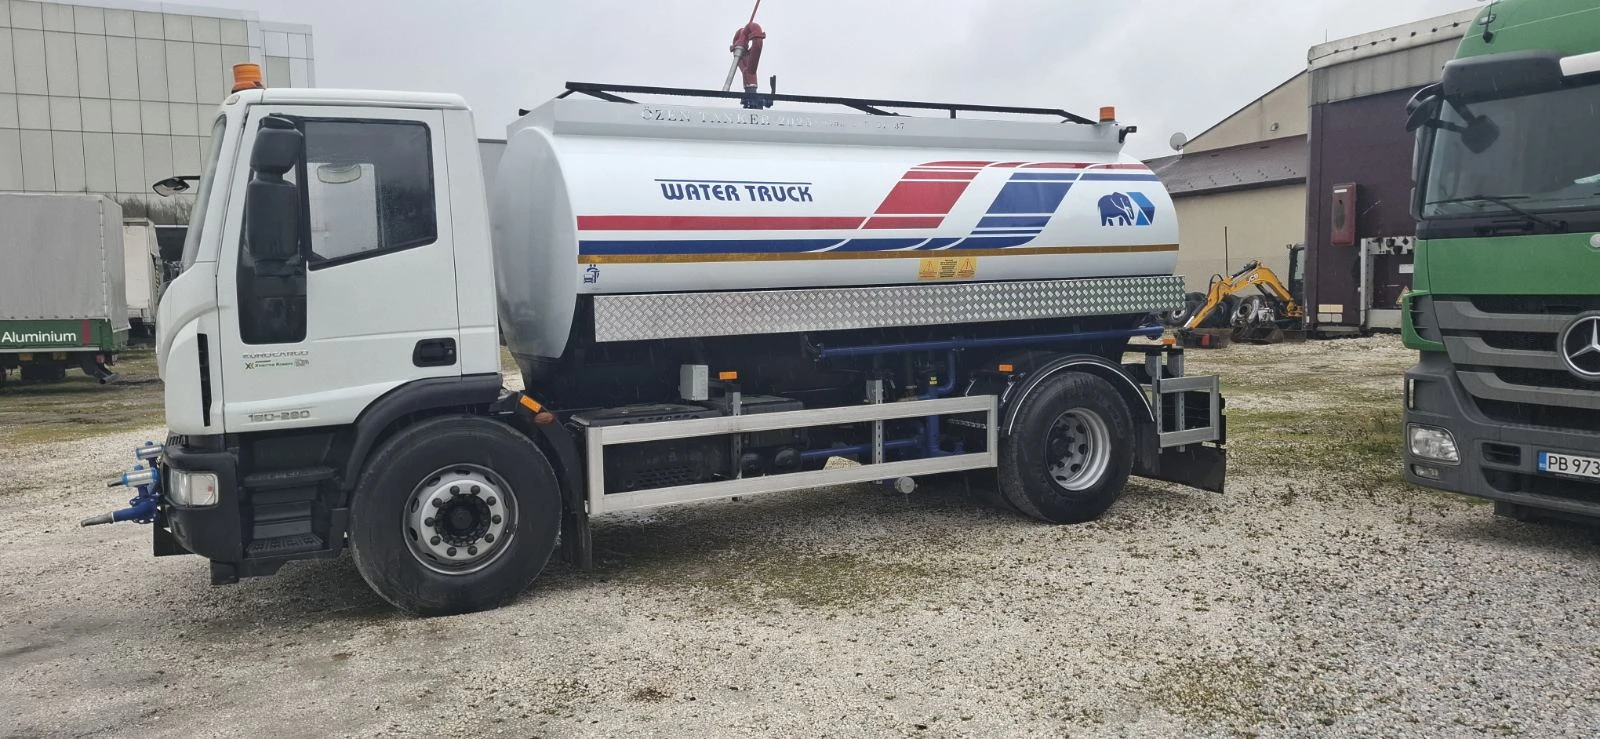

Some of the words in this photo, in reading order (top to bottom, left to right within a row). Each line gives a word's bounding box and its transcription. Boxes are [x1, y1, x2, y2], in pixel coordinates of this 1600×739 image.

[641, 106, 690, 122] ÖZEN
[701, 111, 771, 126] TANKER
[660, 183, 740, 201] WATER
[744, 185, 813, 202] TRUCK
[1, 330, 77, 343] Aluminium
[242, 350, 309, 359] EUROCARGO
[1548, 455, 1569, 471] PB
[1572, 458, 1600, 475] 973
